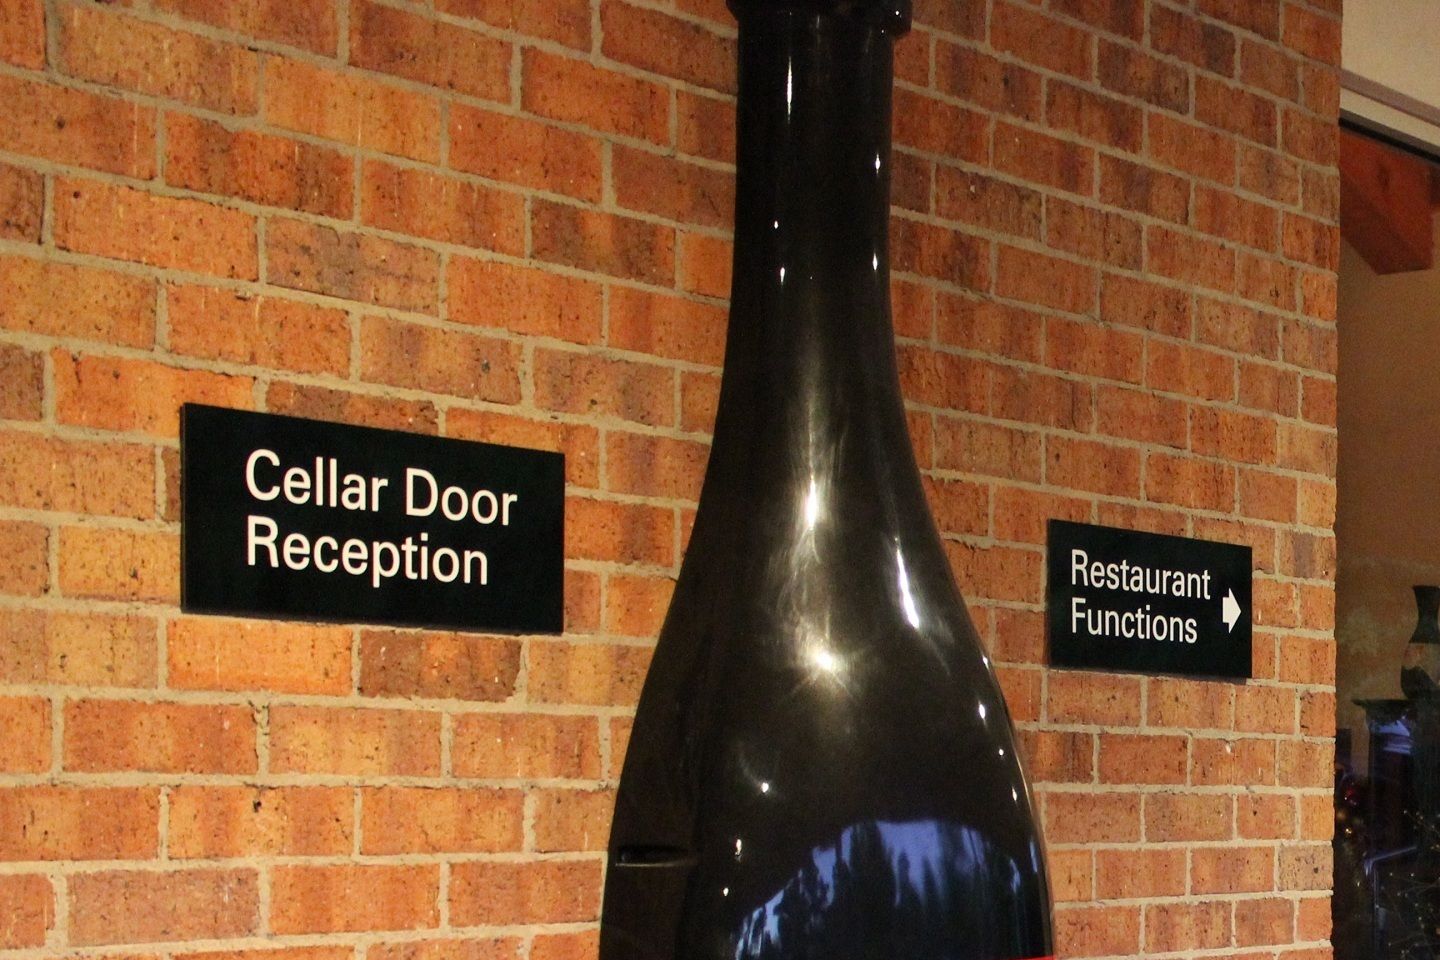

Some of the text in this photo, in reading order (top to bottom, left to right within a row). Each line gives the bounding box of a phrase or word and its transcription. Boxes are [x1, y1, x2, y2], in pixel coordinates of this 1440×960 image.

[245, 449, 518, 526] Cellar Door
[247, 515, 488, 588] Reception
[1071, 549, 1211, 600] Restaurant
[1072, 597, 1198, 644] Functions
